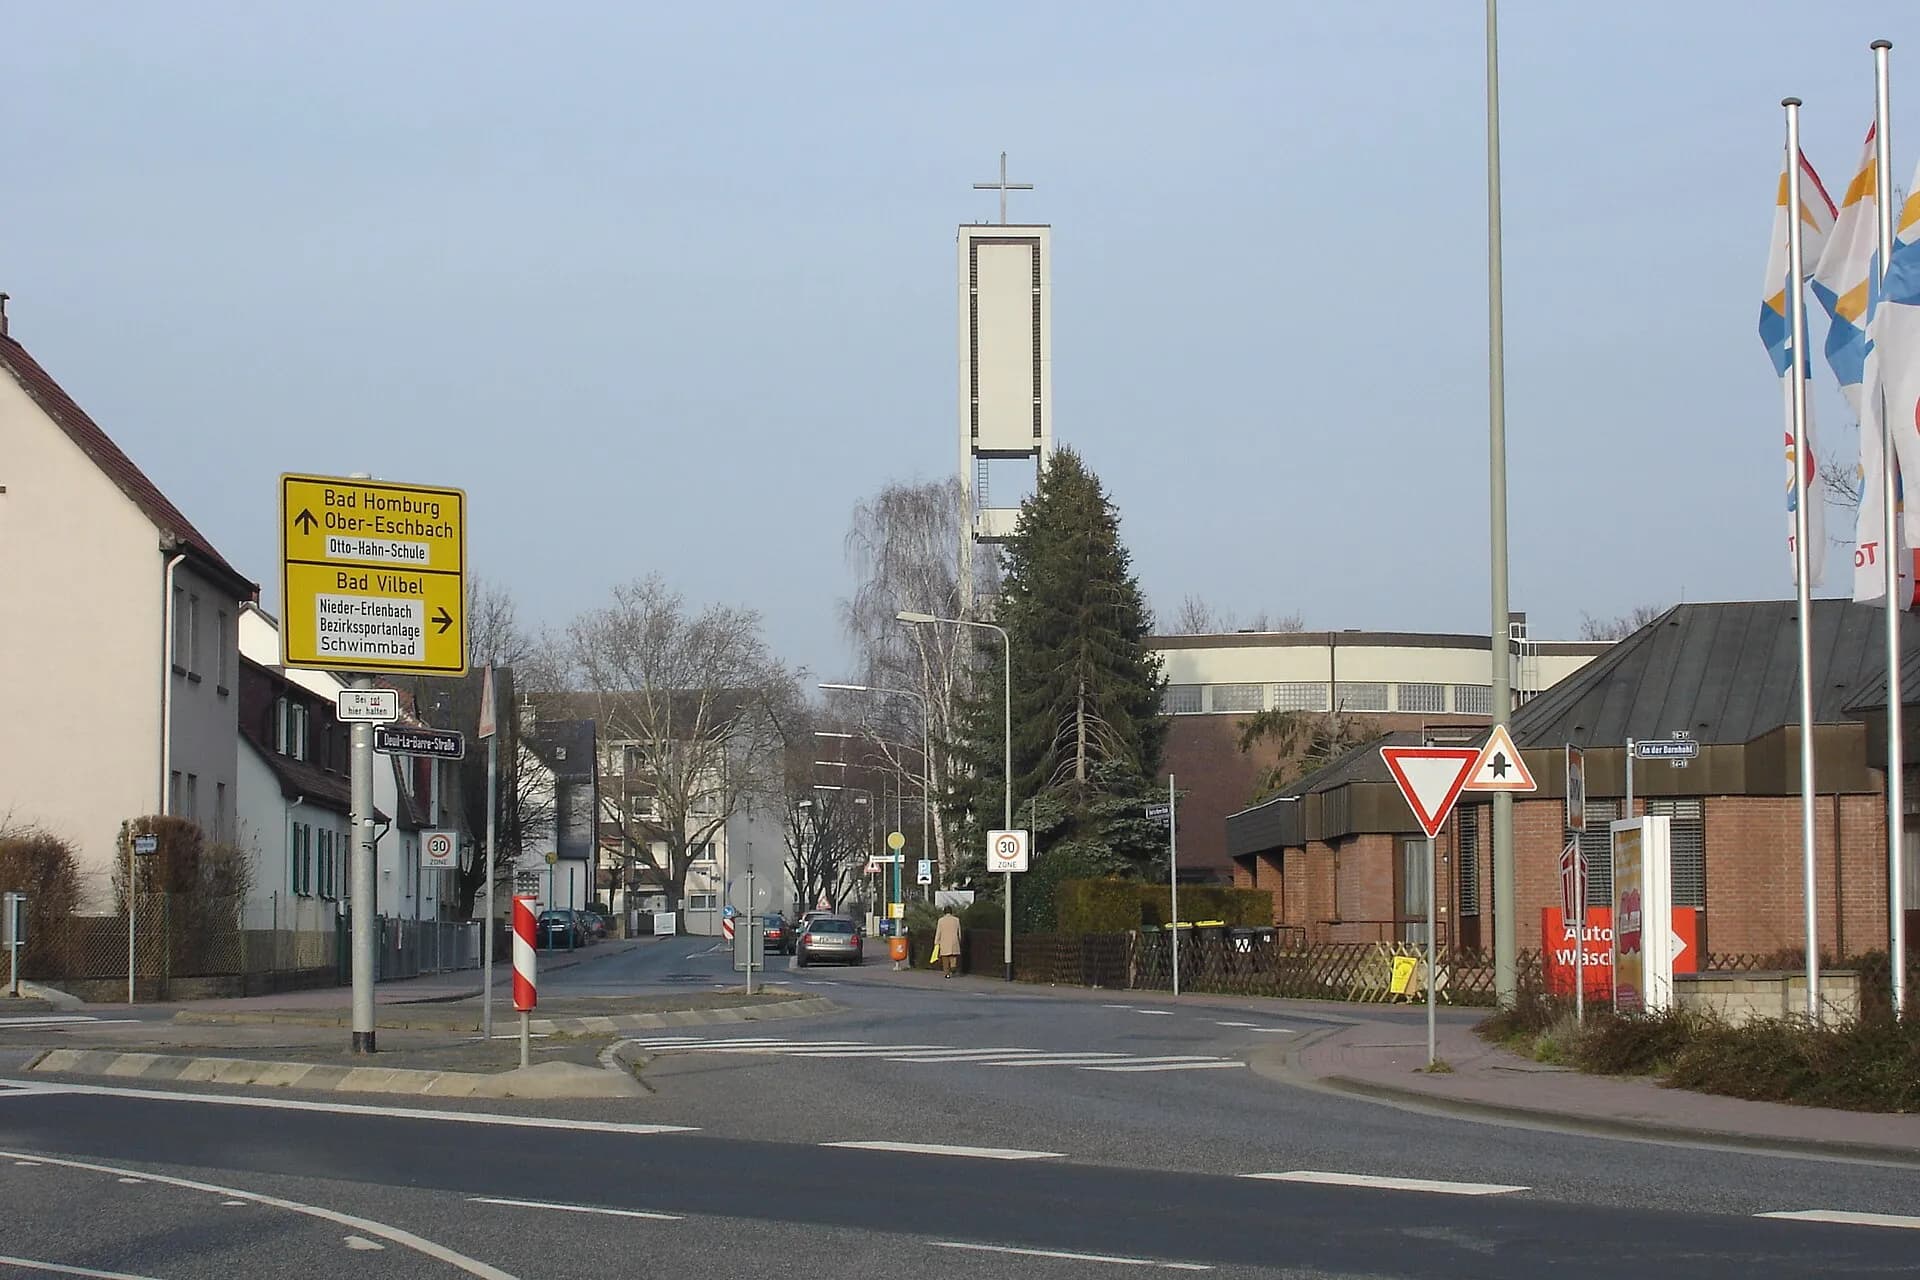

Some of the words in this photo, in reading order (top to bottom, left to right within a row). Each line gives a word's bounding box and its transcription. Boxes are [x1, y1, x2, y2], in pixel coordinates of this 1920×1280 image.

[325, 489, 356, 508] Bad
[364, 492, 440, 519] Homburg
[325, 512, 453, 538] Ober-Eschbach
[330, 538, 425, 560] Otto-Hahn-Schule
[337, 572, 368, 590] Bad
[377, 575, 424, 594] Vilbel
[319, 599, 412, 619] Nieder-Erlenbach
[320, 617, 420, 641] Bezirkssportanlage
[321, 636, 415, 655] Schwimmbad
[355, 694, 366, 703] Bei
[348, 706, 362, 715] hier
[366, 706, 388, 715] halten
[1642, 746, 1650, 754] An
[1651, 745, 1662, 754] der
[432, 840, 446, 851] 30
[1000, 841, 1015, 853] 30
[998, 861, 1017, 869] ZONE
[1563, 926, 1613, 942] Auto
